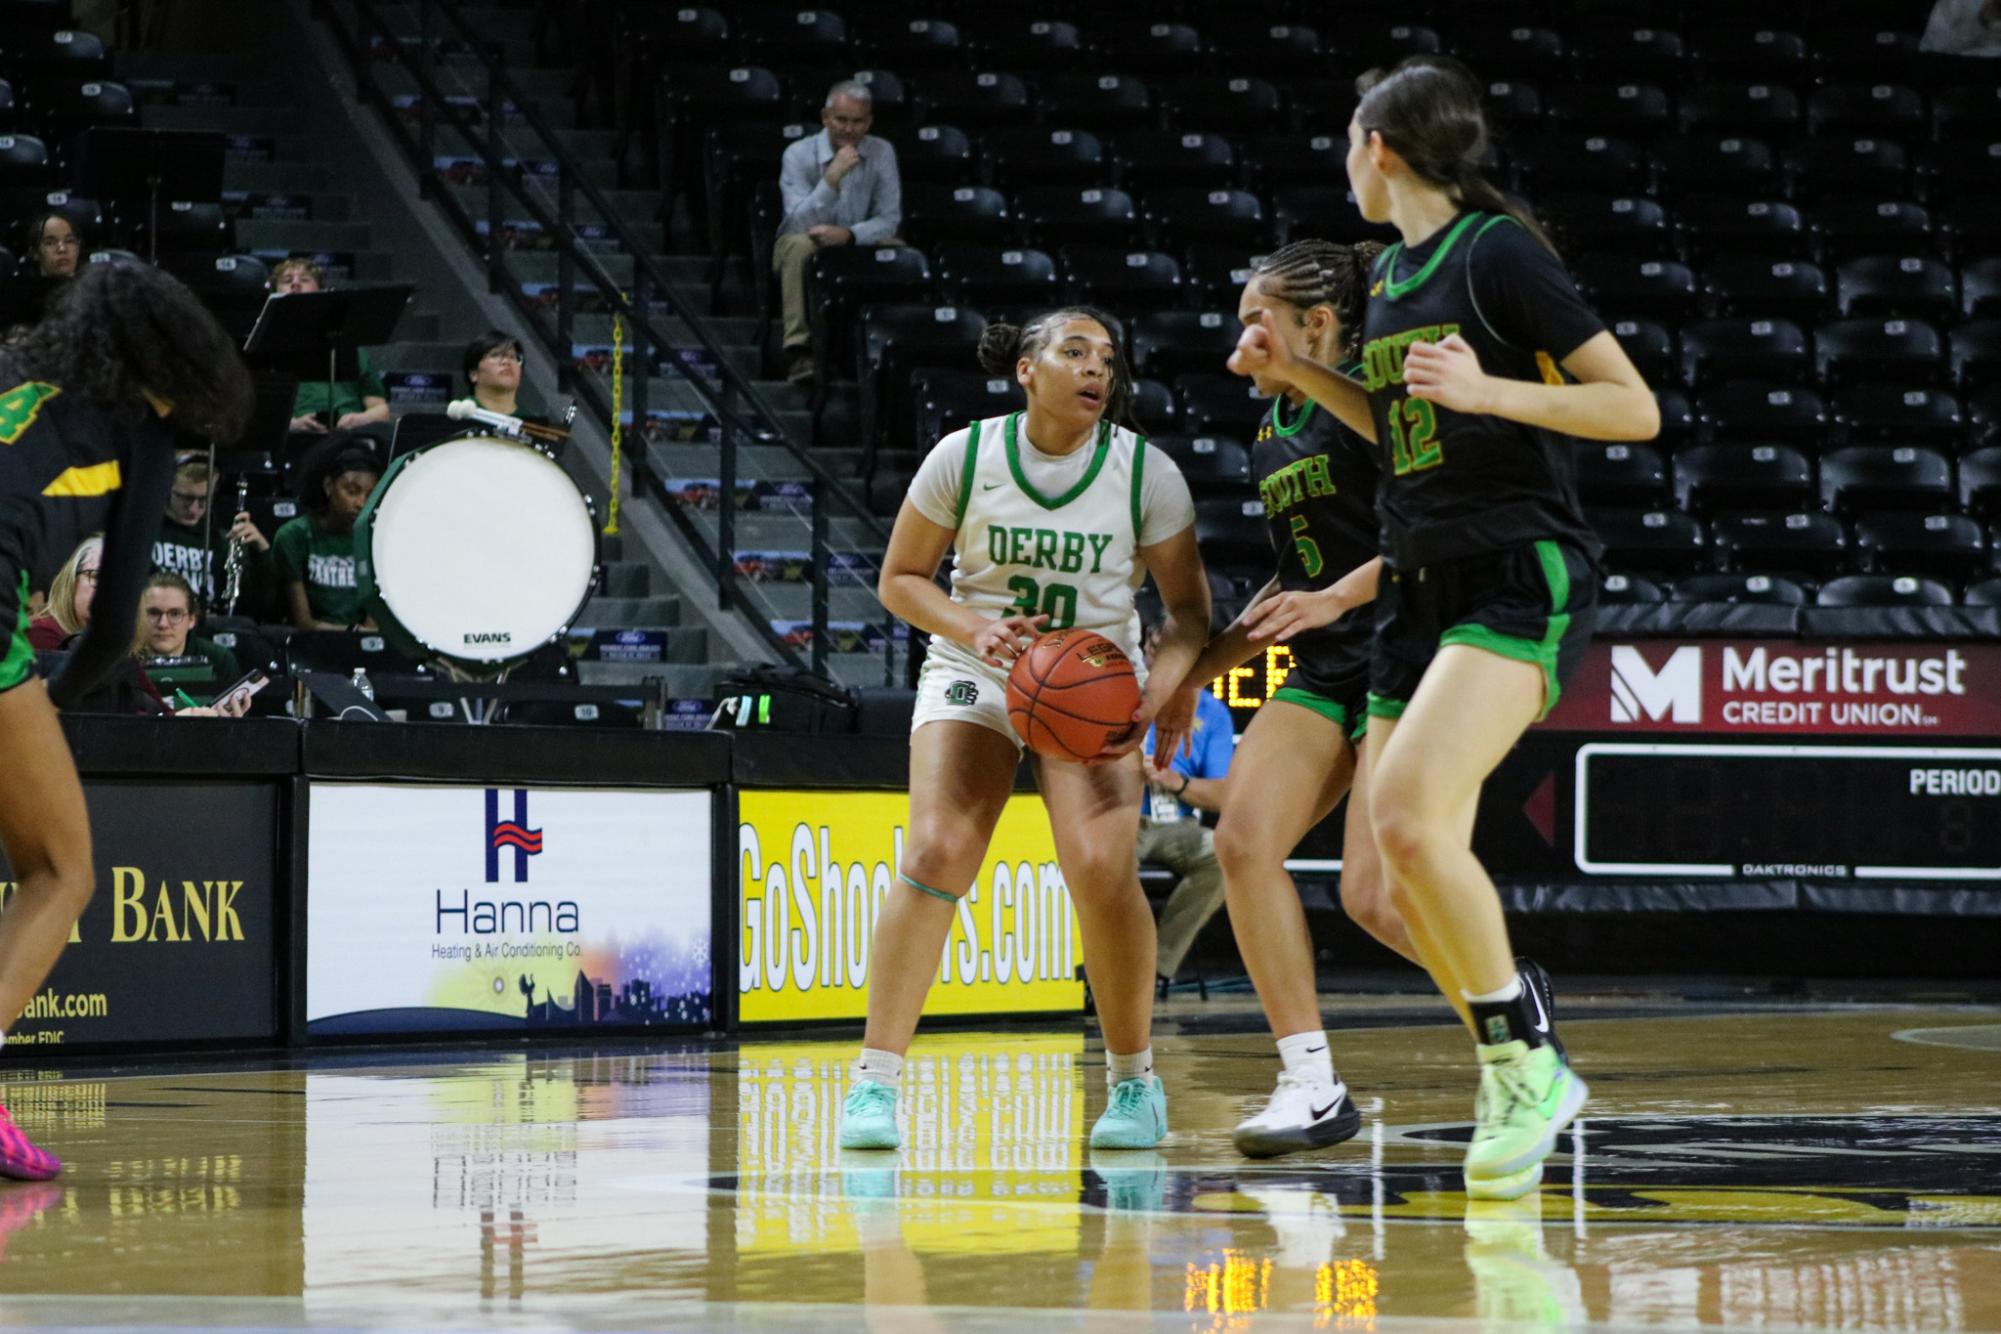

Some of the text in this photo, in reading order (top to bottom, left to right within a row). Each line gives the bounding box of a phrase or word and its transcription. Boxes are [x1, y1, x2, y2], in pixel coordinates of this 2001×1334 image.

[1389, 397, 1443, 475] 12
[987, 524, 1114, 574] DERBY
[1289, 514, 1323, 578] 5
[464, 632, 511, 644] EVANS
[1722, 646, 1966, 695] Meritrust
[1722, 701, 1823, 725] CREDIT
[1831, 703, 1922, 727] UNION
[1909, 768, 2001, 796] PERIOD
[1742, 864, 1848, 877] DAKTRONICS
[437, 889, 579, 934] Hanna
[431, 943, 472, 961] Heating
[474, 944, 482, 958] &
[485, 943, 498, 958] Air
[501, 942, 564, 961] Conditioning
[38, 1030, 65, 1044] FDIC
